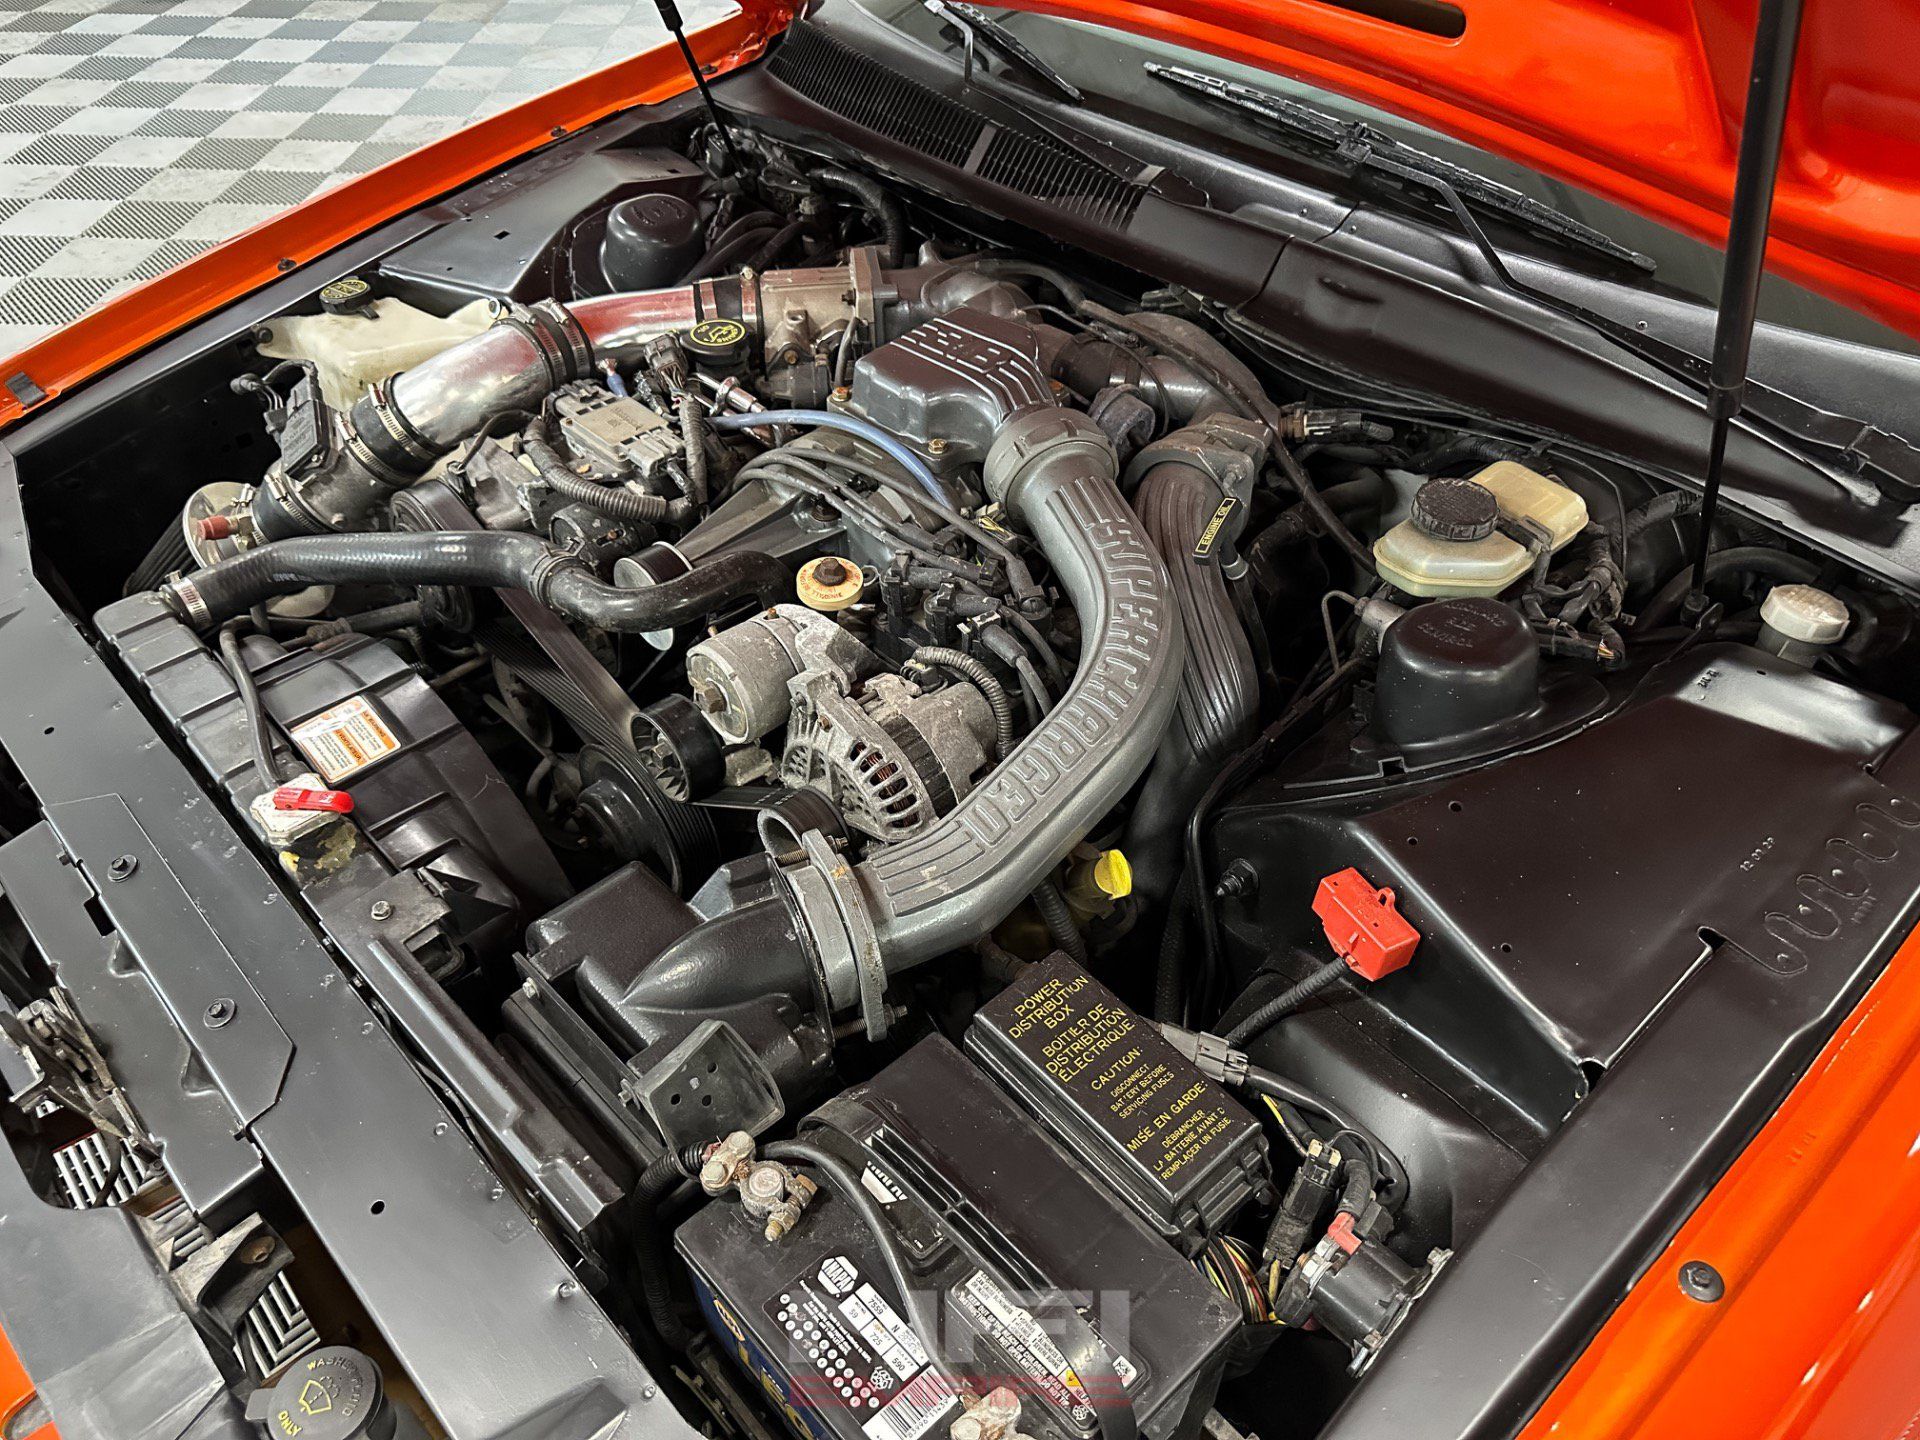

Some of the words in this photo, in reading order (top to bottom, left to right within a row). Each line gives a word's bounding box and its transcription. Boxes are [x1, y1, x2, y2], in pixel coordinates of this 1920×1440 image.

[1199, 515, 1223, 546] ENGINE
[1216, 501, 1230, 517] OIL
[963, 518, 1158, 847] SUPERCHARGED
[1008, 974, 1089, 1039] DISTRIBUTION
[1014, 978, 1064, 1017] POWER
[1087, 1003, 1110, 1023] DE
[1043, 1004, 1076, 1030] BOX
[1046, 1008, 1127, 1074] DISTRIBUTION
[1091, 1046, 1144, 1091] CAUTION:
[1110, 1064, 1149, 1098] DISCONNECT
[1140, 1064, 1167, 1088] BEFORE
[1119, 1090, 1152, 1119] SERVICING
[1150, 1071, 1175, 1096] FUSES
[1127, 1125, 1155, 1152] MISE
[1153, 1111, 1172, 1130] EN
[1170, 1080, 1209, 1114] GARDE:
[1160, 1141, 1202, 1180] REMPLACER
[1199, 1132, 1212, 1146] UN
[1164, 1131, 1198, 1163] BATTERIE
[1196, 1115, 1219, 1136] AVANT
[822, 1259, 855, 1292] NAPA
[848, 1308, 859, 1319] 59
[867, 1298, 884, 1315] 7559
[890, 1323, 900, 1333] N
[966, 1293, 980, 1307] KEEP
[977, 1304, 989, 1317] OUT
[868, 1331, 883, 1346] 725
[307, 1356, 358, 1375] WASHER
[891, 1356, 906, 1372] 590
[997, 1335, 1010, 1348] NOT
[1006, 1345, 1022, 1361] OPEN
[1047, 1386, 1060, 1399] NOT
[278, 1410, 302, 1437] ONLY
